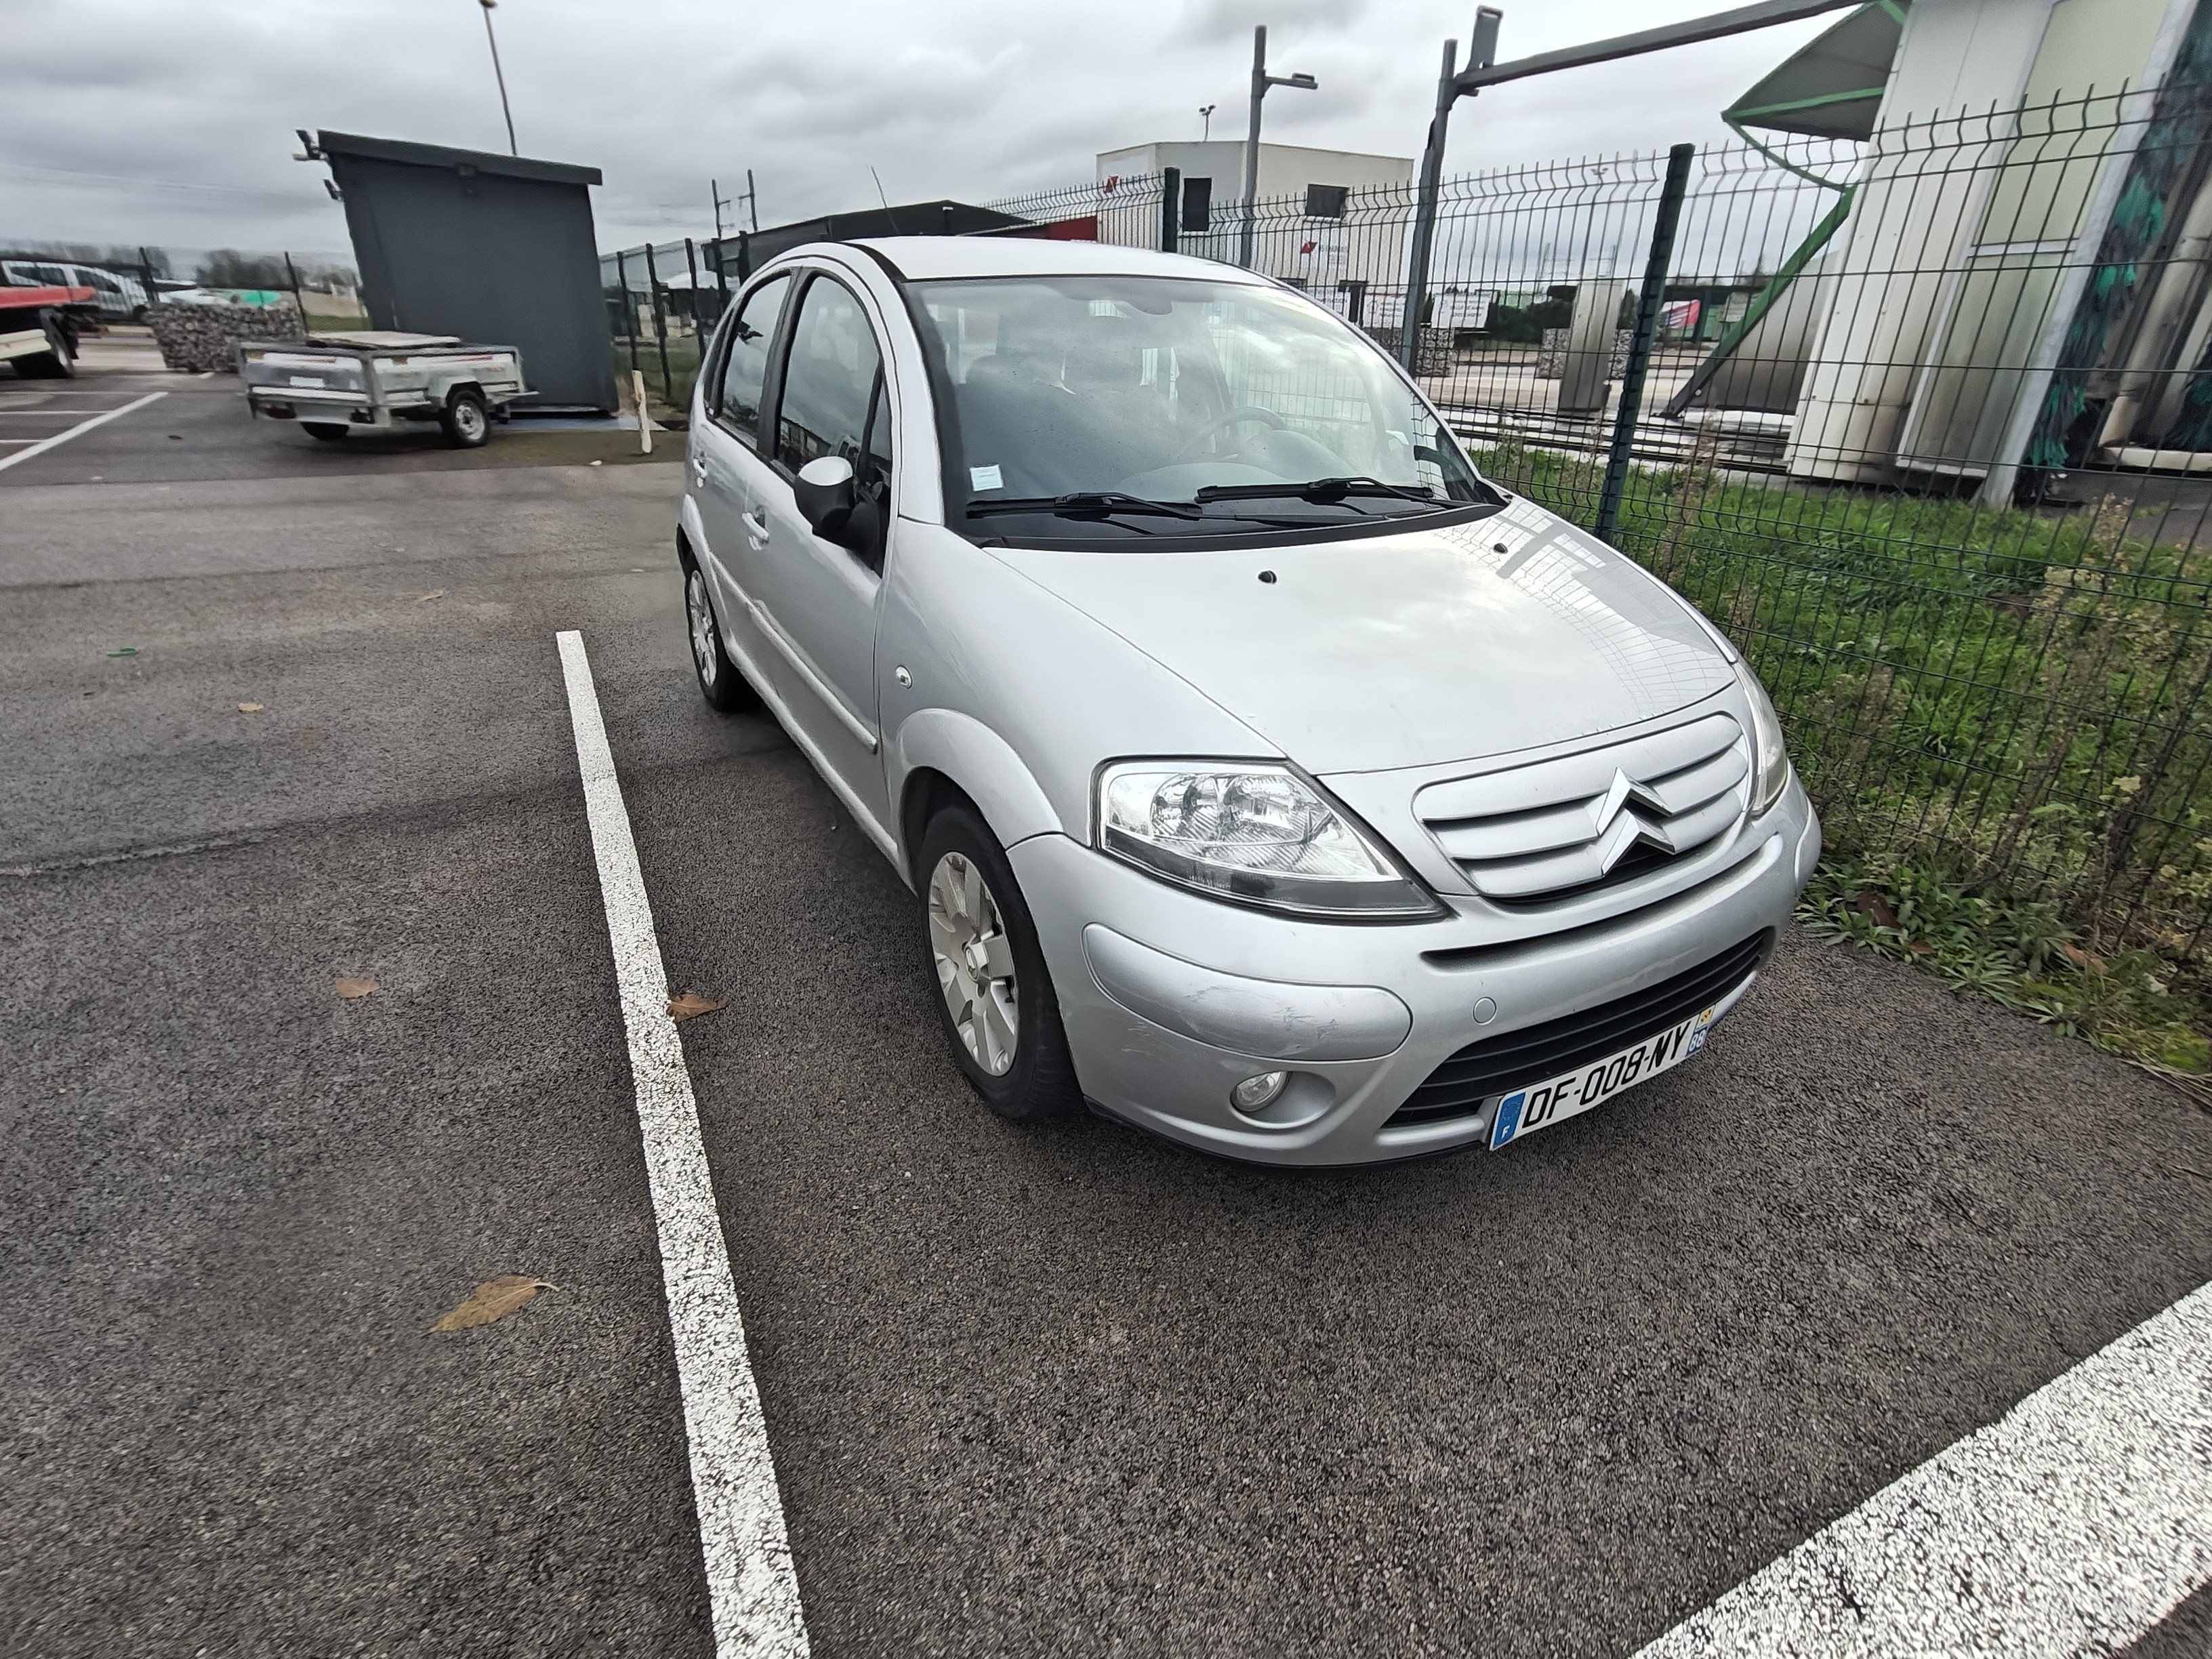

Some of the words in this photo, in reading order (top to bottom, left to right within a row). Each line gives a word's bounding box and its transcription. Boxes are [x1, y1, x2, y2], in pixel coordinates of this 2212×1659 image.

[1689, 1029, 1706, 1052] 88
[1522, 1021, 1692, 1128] DF-008-NY
[1501, 1124, 1511, 1140] F
